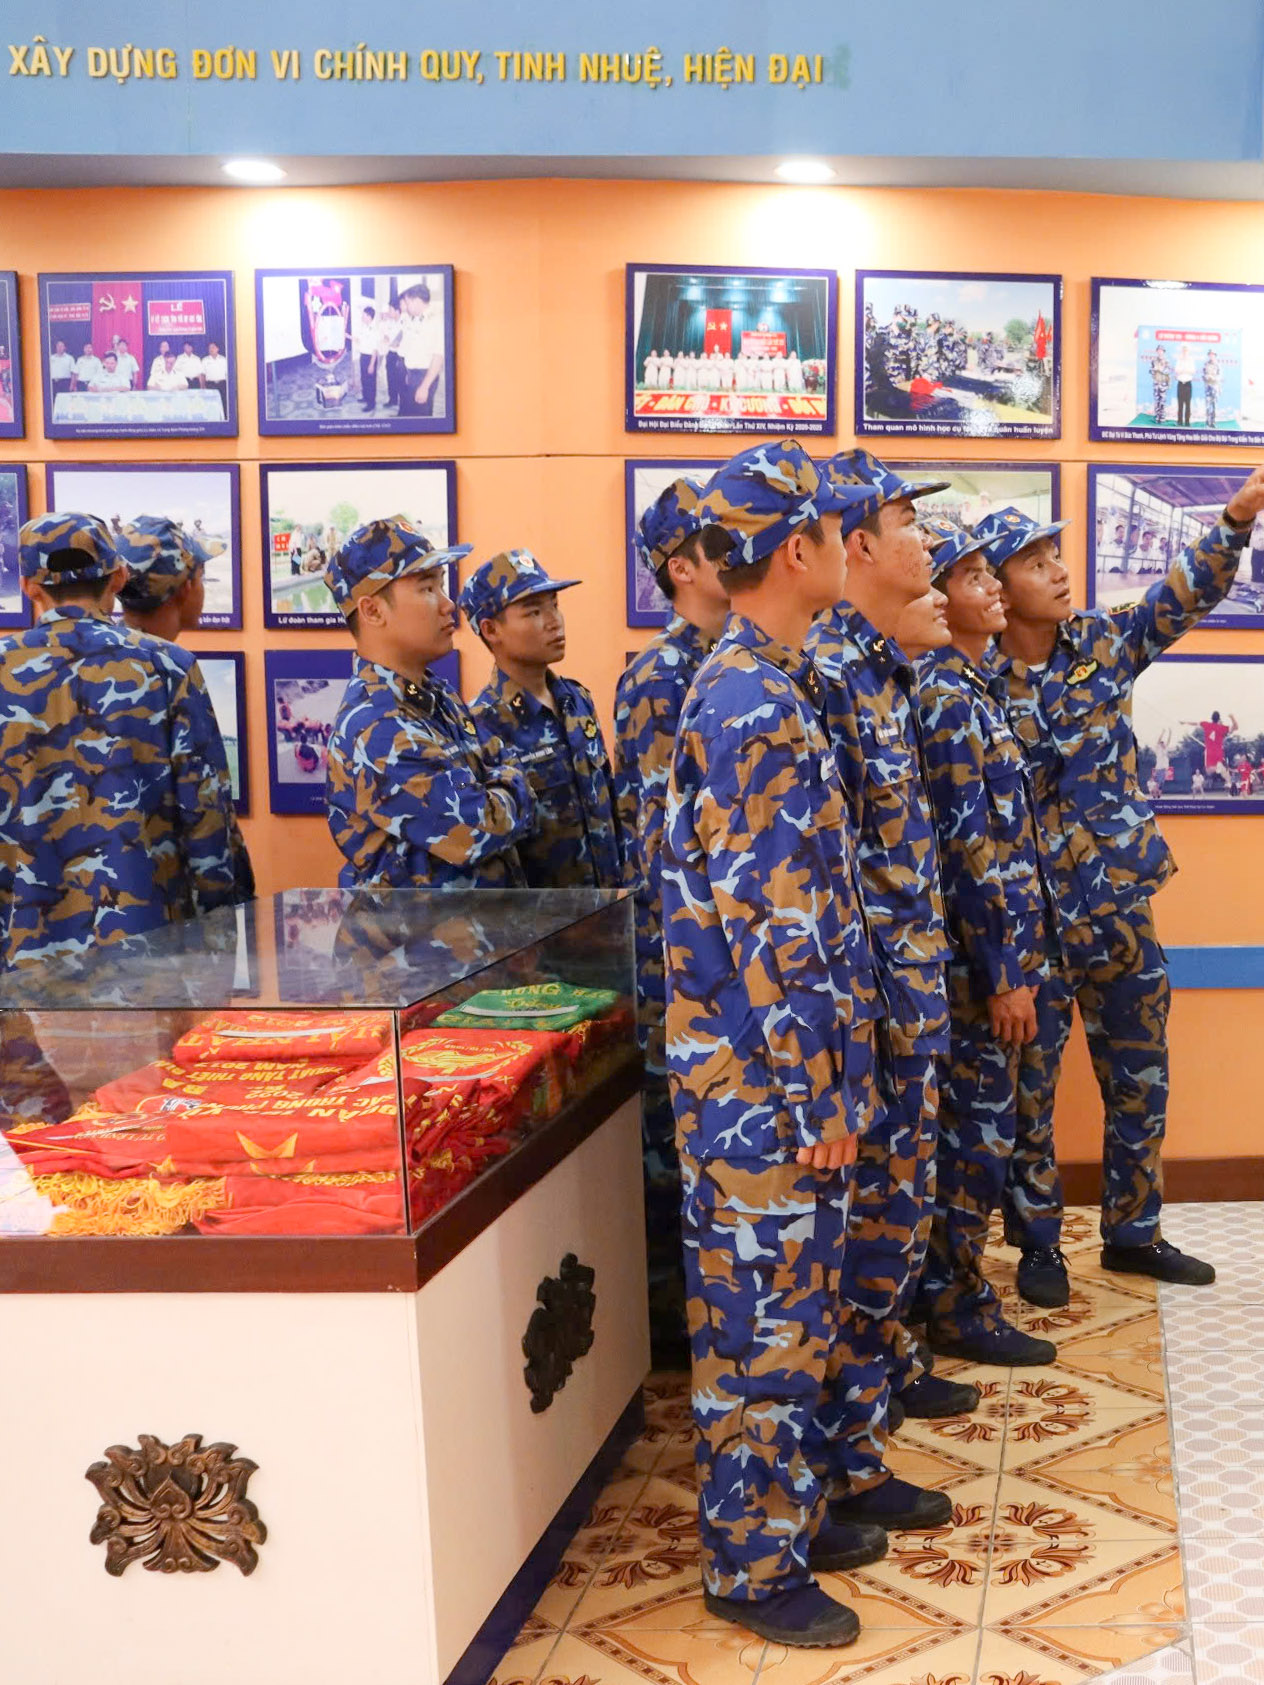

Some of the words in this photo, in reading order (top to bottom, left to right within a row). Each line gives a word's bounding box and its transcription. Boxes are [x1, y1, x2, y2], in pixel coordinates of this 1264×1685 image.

[8, 35, 74, 77] XÂY
[87, 43, 178, 84] DỰNG
[192, 44, 257, 80] ĐƠN
[314, 42, 408, 81] CHÍNH
[420, 50, 485, 84] QUY,
[494, 51, 565, 81] TINH
[579, 46, 674, 90] NHUỆ,
[683, 46, 755, 90] HIỆN
[767, 53, 824, 90] ĐẠI
[863, 423, 884, 431] Tham
[885, 424, 904, 432] quan
[905, 423, 917, 431] mô
[936, 424, 951, 433] học
[1013, 425, 1032, 433] huấn
[1033, 426, 1053, 435] luyện
[278, 616, 288, 624] Lữ
[288, 616, 305, 624] đoàn
[325, 617, 336, 625] gia
